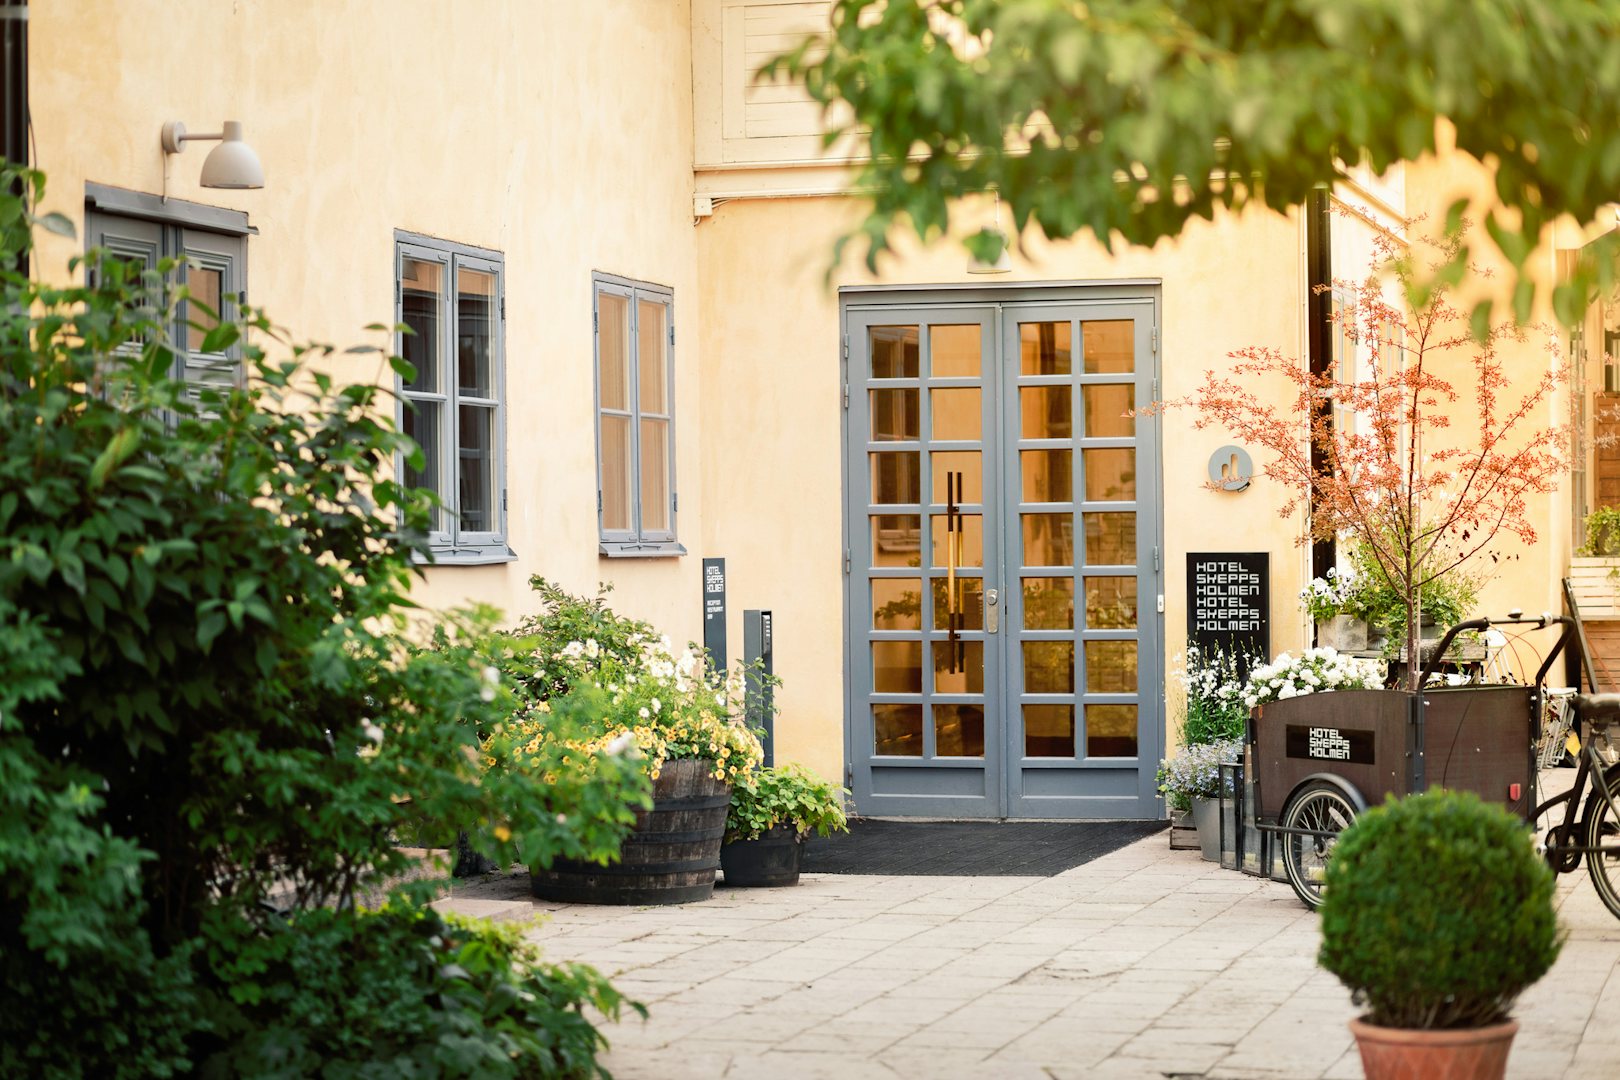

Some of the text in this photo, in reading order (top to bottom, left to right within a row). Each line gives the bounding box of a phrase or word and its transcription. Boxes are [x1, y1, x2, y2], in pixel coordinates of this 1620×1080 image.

[1196, 562, 1248, 572] HOTEL
[1196, 573, 1259, 584] SKEPPS
[1196, 585, 1259, 595] HOLMEN
[1196, 597, 1248, 607] HOTEL
[1196, 609, 1259, 619] SKEPPS
[1196, 621, 1259, 631] HOLMEN
[1309, 727, 1343, 739] HOTEL
[1309, 737, 1350, 750] SKEPPS
[1309, 747, 1350, 760] HOLMEN
